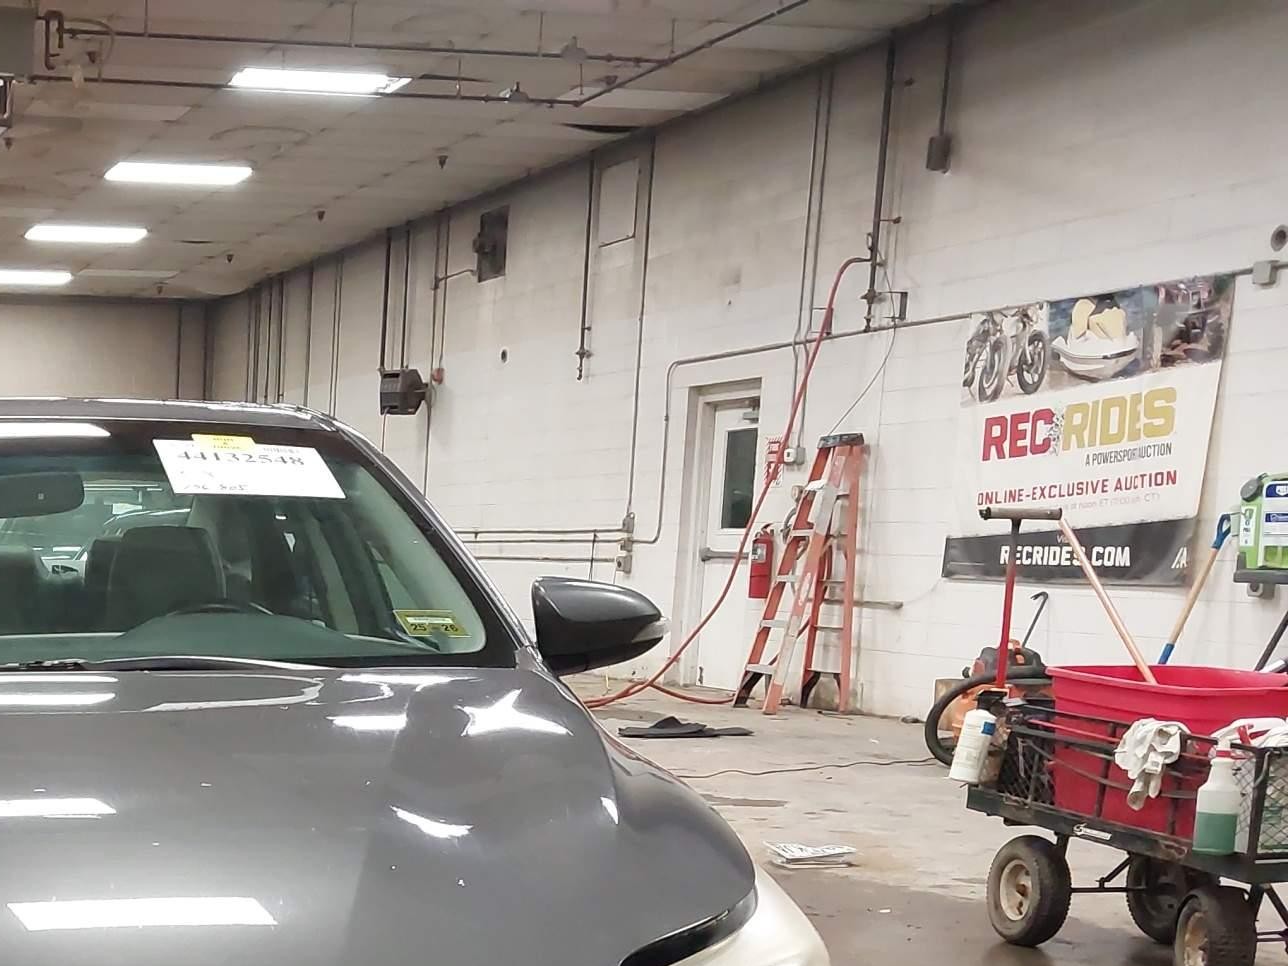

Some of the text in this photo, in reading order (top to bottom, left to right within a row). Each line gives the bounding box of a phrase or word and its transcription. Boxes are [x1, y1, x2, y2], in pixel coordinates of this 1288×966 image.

[982, 387, 1177, 461] REC RIDES
[176, 450, 305, 466] 44132548
[1085, 453, 1091, 467] A
[977, 478, 1109, 506] ONLINE-EXCLUSIVE
[1114, 470, 1178, 492] AUCTION
[999, 545, 1131, 567] RECRIDESCOM
